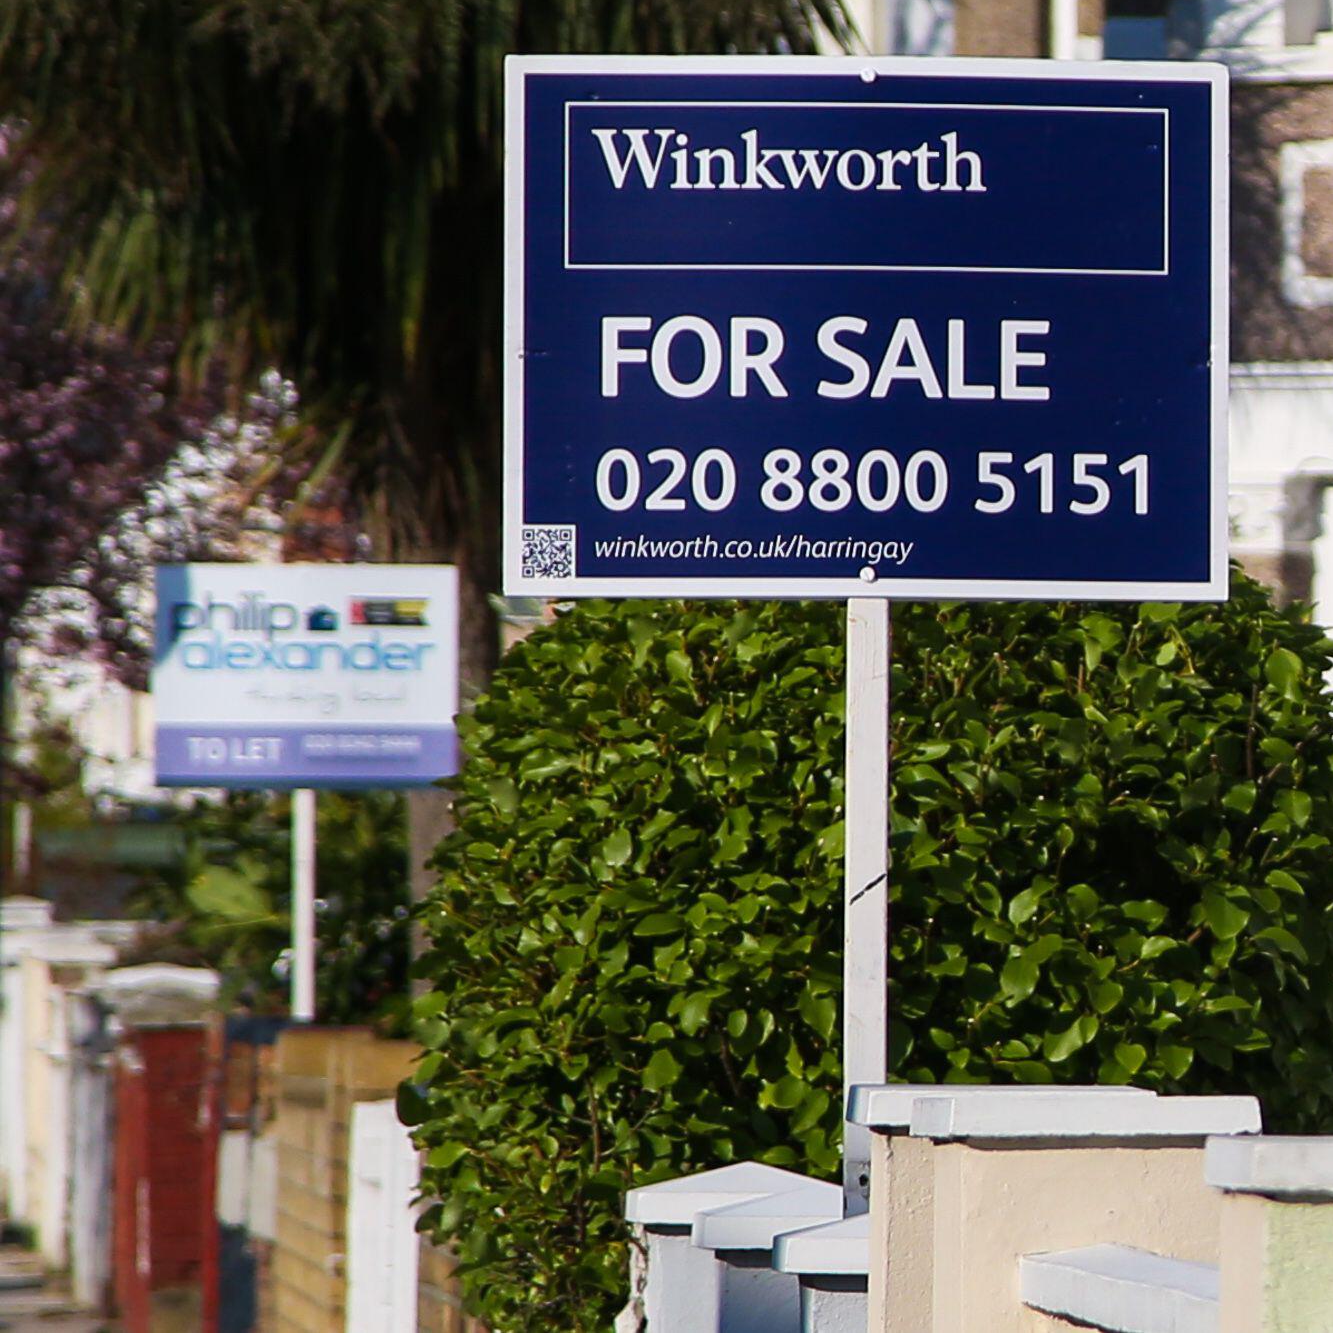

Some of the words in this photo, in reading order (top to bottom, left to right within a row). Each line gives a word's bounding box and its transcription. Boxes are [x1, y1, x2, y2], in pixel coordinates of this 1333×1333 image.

[591, 128, 987, 192] Winkworth
[601, 315, 789, 399] FOR
[817, 316, 1051, 401] SALE
[595, 448, 736, 512] 020
[760, 448, 949, 513] 8800
[974, 451, 1149, 515] 5151
[594, 533, 914, 565] winkworth.co.uk/harringay
[171, 591, 297, 641] philip
[181, 629, 434, 671] alexander
[187, 736, 228, 762] TO
[230, 736, 283, 762] LET
